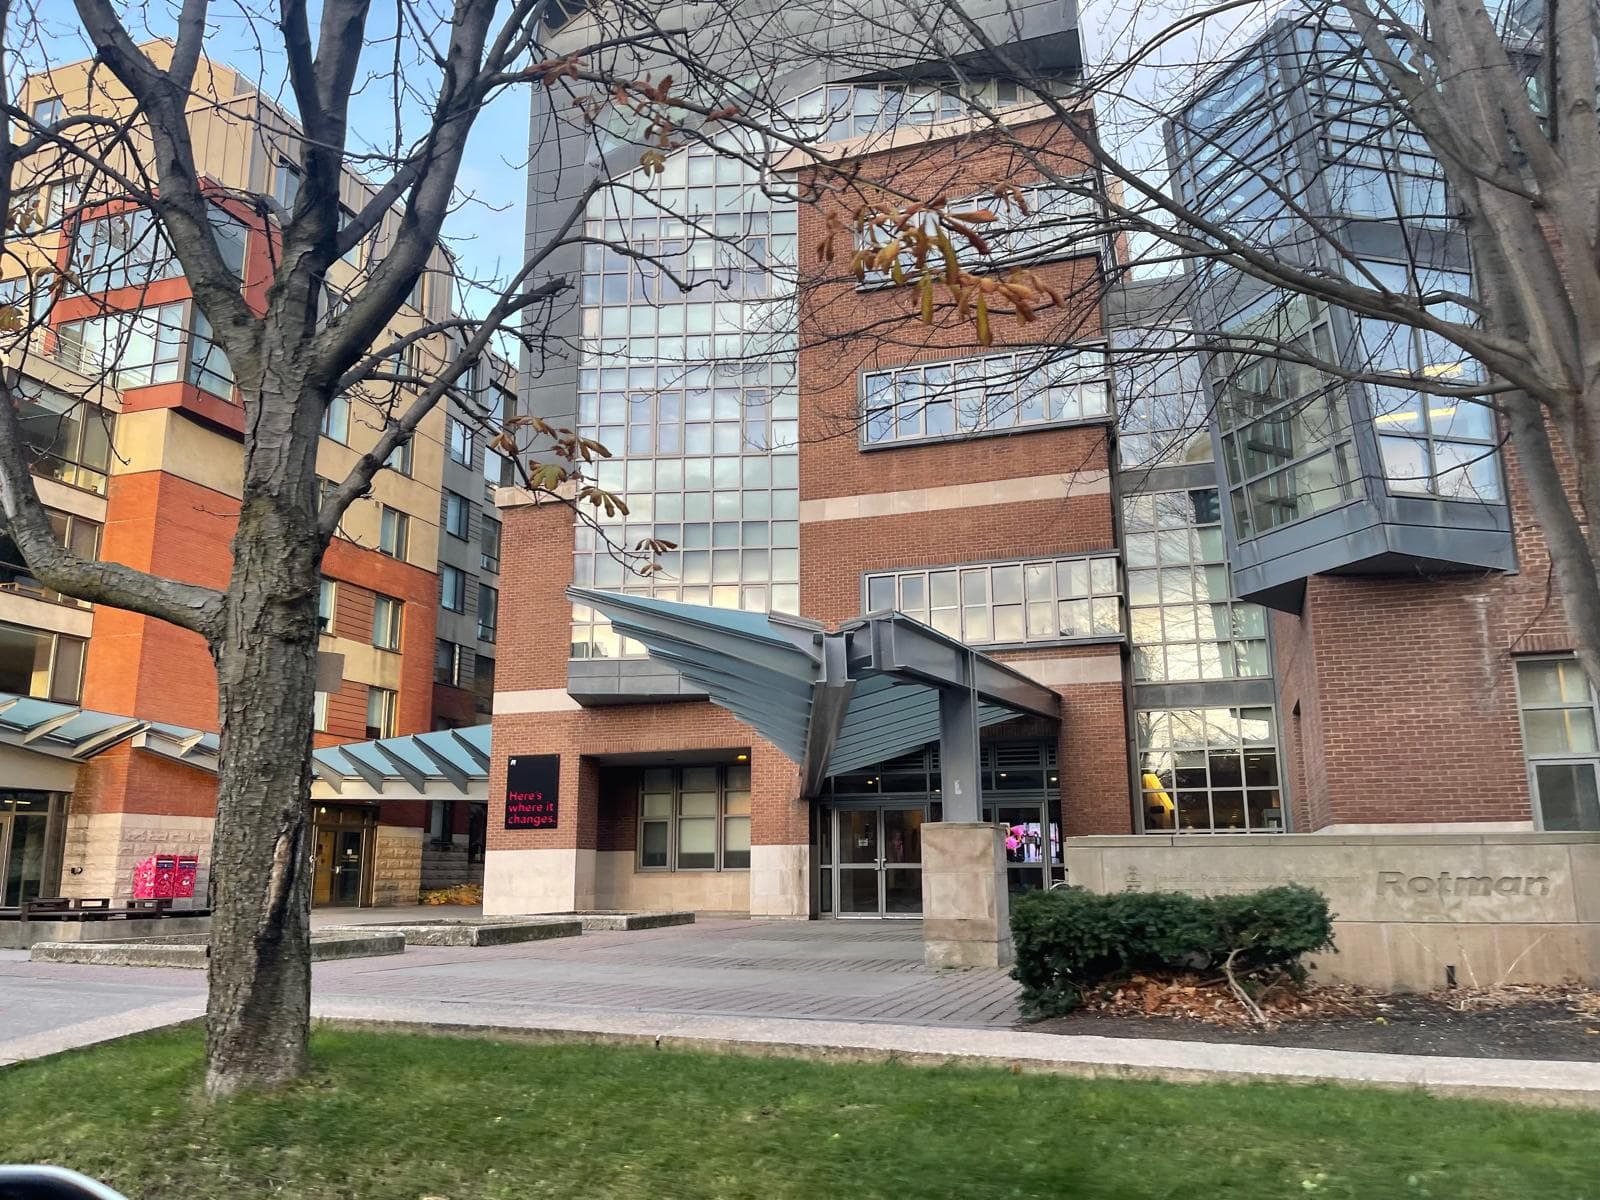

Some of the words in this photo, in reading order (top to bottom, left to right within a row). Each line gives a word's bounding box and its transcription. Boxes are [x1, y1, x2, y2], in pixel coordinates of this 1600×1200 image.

[509, 792, 542, 801] Here's
[508, 803, 543, 812] where
[546, 802, 554, 811] it
[1376, 871, 1550, 897] Rotman
